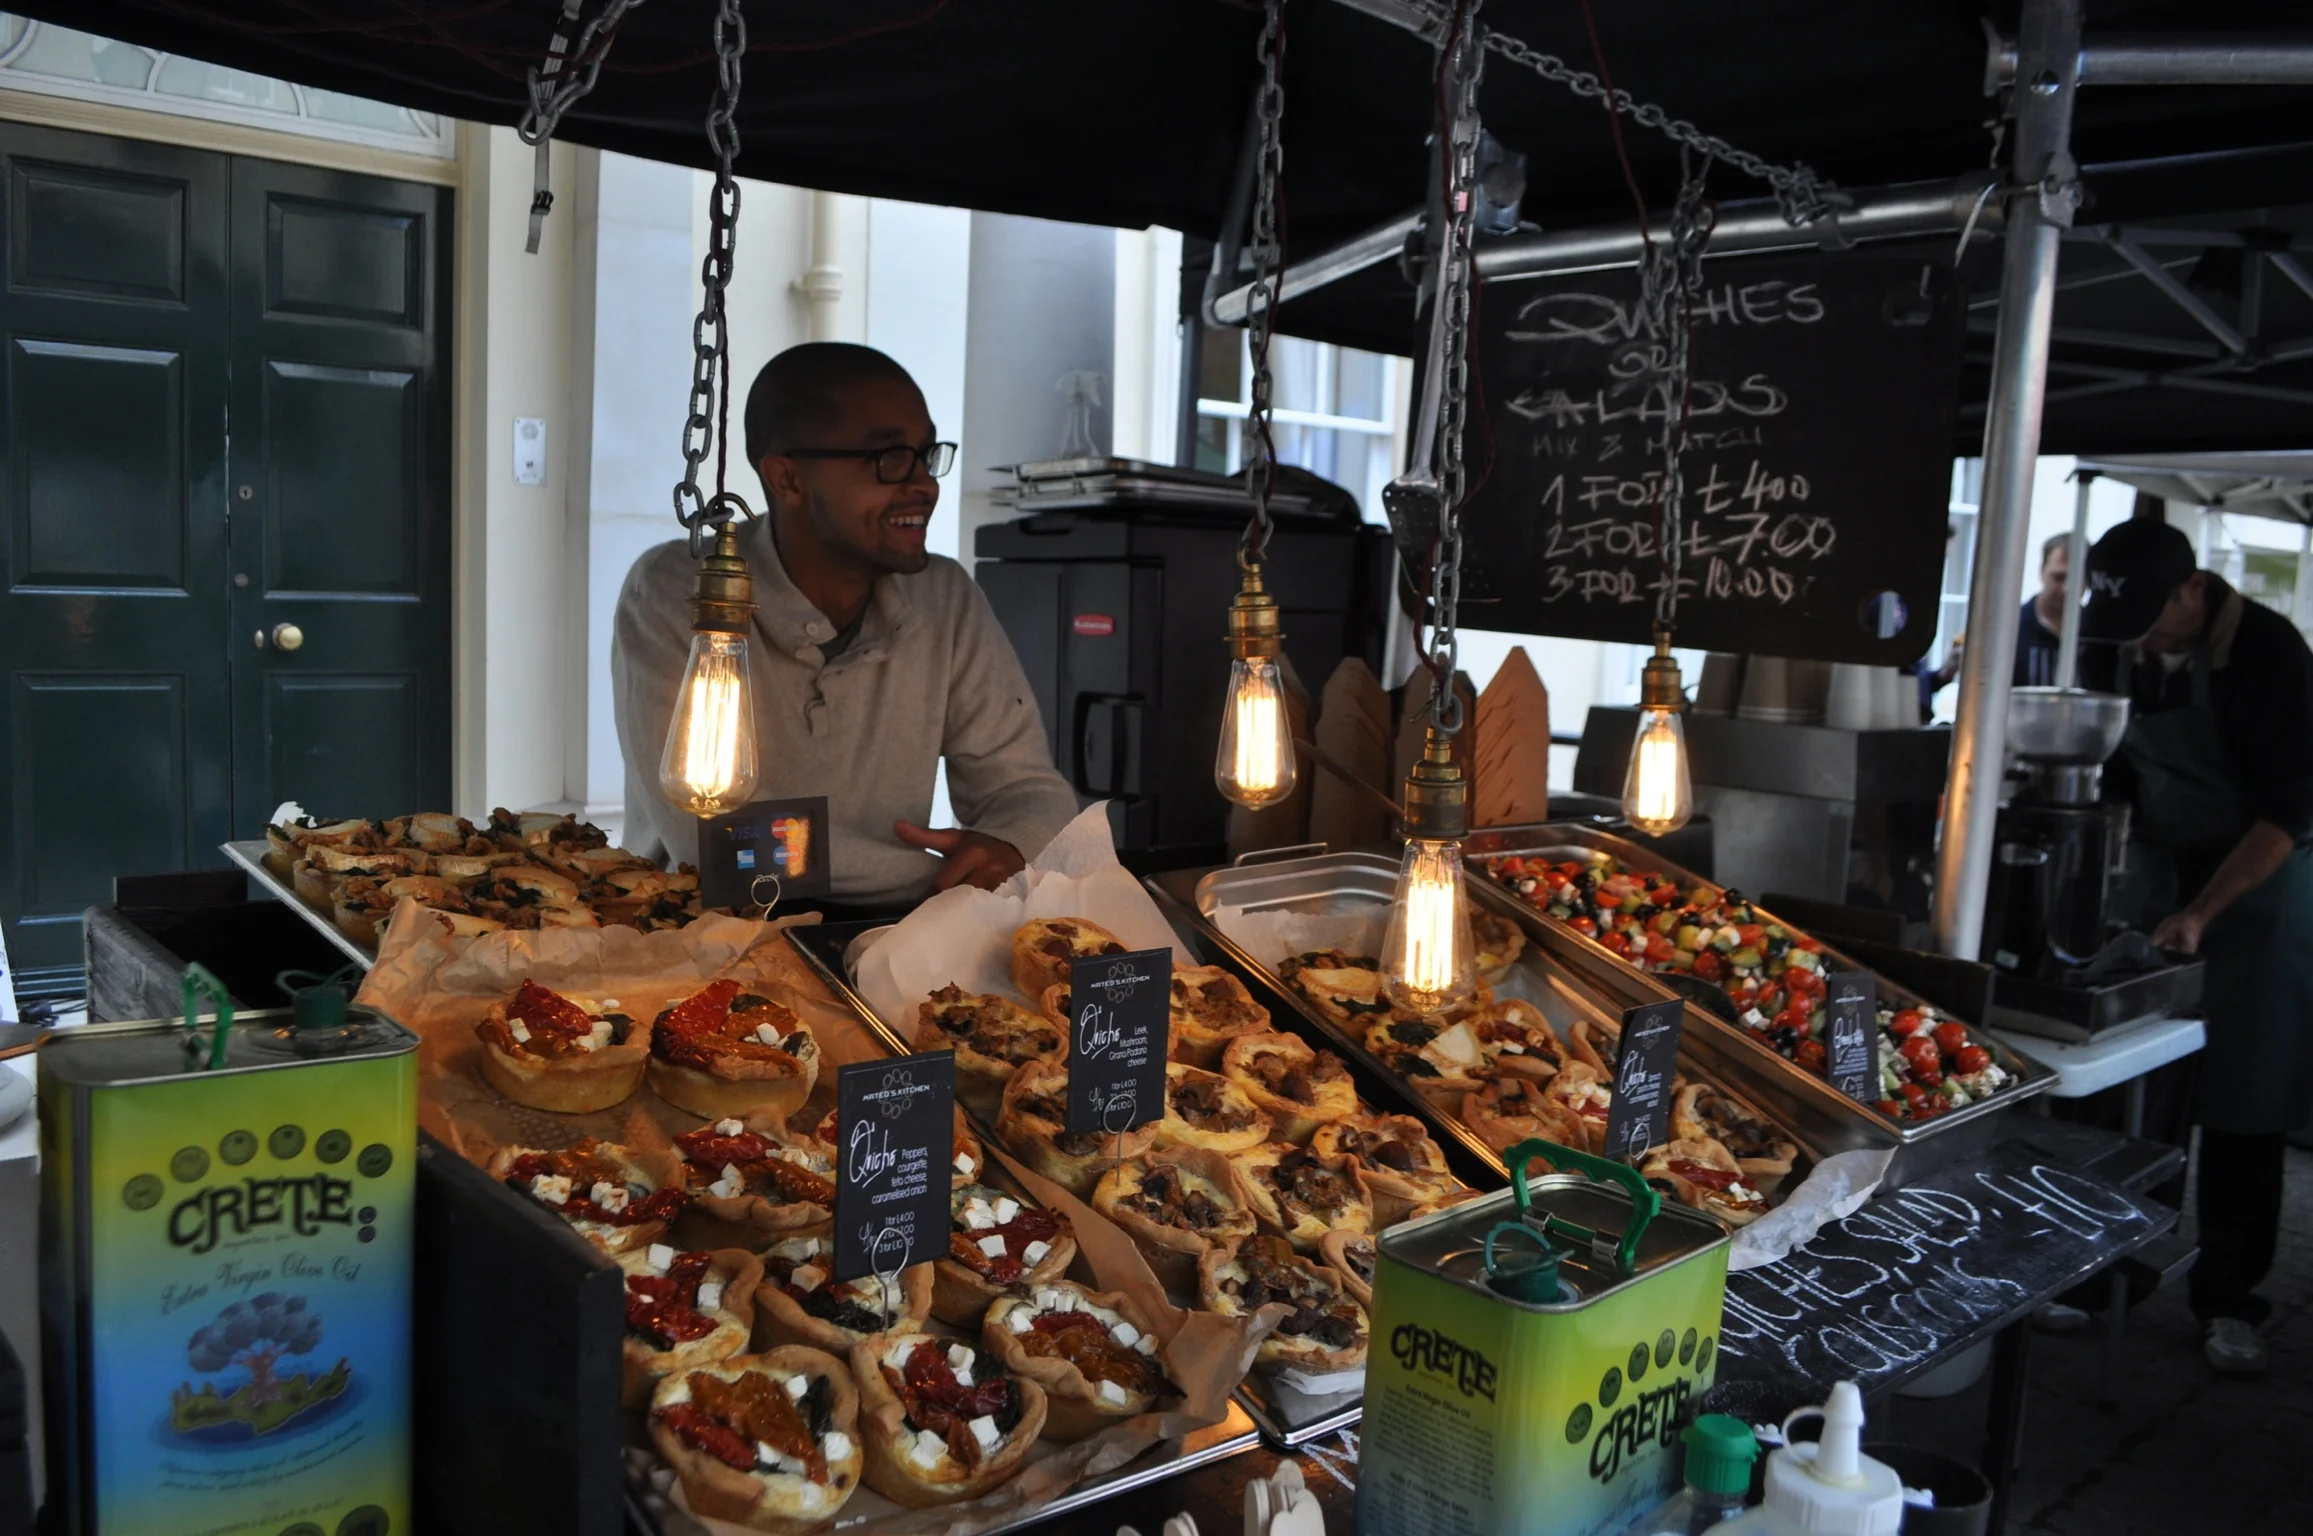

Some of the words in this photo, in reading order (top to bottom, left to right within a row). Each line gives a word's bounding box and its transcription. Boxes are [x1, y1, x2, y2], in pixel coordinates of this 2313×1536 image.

[1541, 473, 1564, 515] 1
[1545, 519, 1573, 559] 2
[1567, 517, 1657, 559] FOR
[1541, 564, 1574, 603] 3
[1576, 565, 1646, 604] FOR
[1128, 1057, 1147, 1067] cheese
[891, 1176, 904, 1187] feta
[910, 1184, 927, 1196] onion
[169, 1171, 353, 1255] CRETE
[216, 1258, 273, 1294] Virgin
[282, 1251, 325, 1279] Olive
[332, 1254, 362, 1282] Oil
[1390, 1322, 1498, 1404] CRETE
[1589, 1377, 1691, 1486] CRETE
